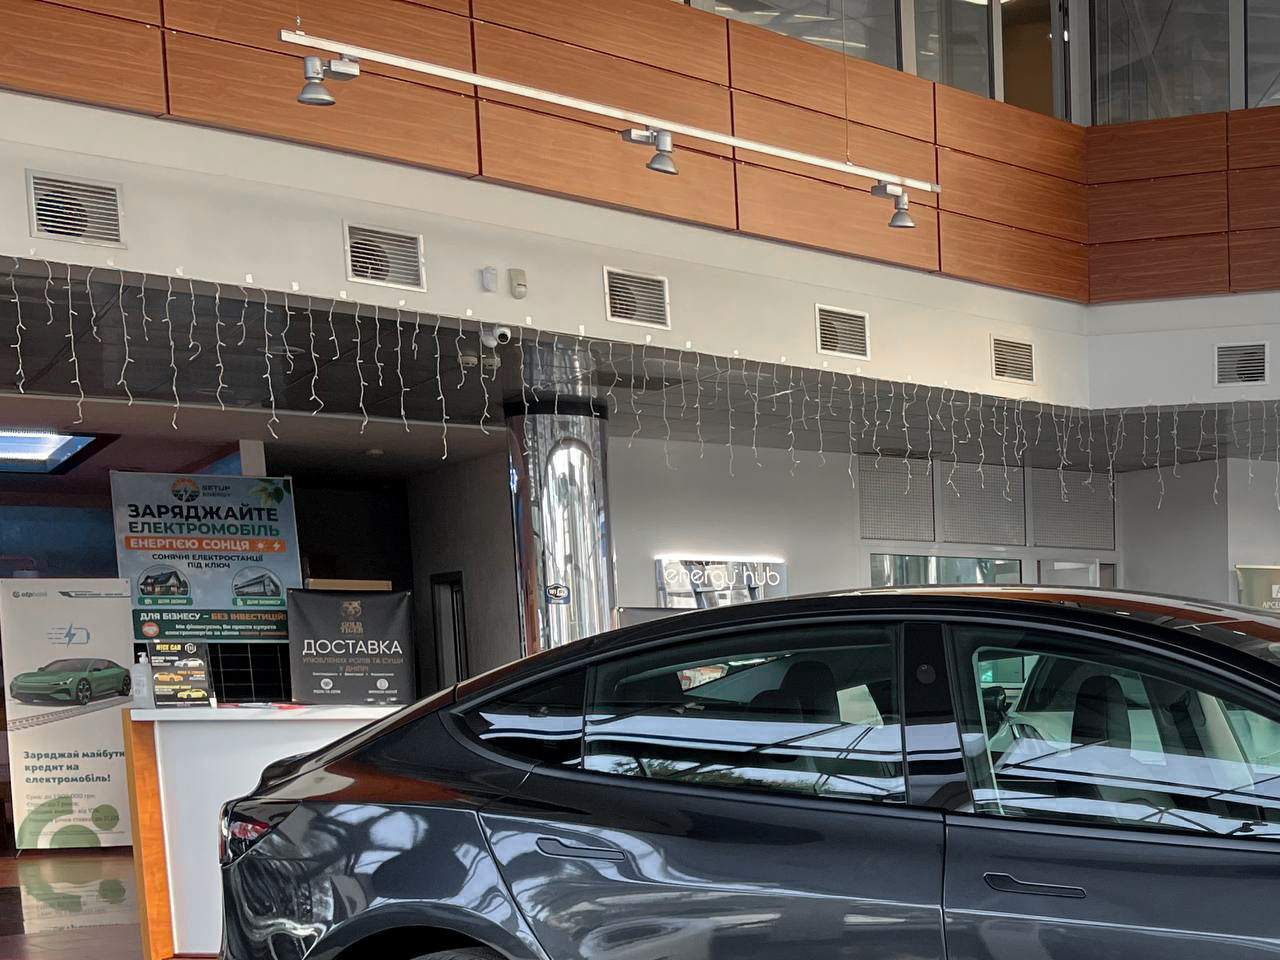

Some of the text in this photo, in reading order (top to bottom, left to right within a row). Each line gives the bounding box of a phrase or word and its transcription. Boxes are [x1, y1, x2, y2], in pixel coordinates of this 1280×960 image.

[127, 503, 279, 521] ЗАРЯДЖАЙТЕ
[128, 521, 280, 536] ЕЛЕКТРОМОБІЛЬ
[130, 538, 250, 551] ЕНЕРГІЄЮ СОНЦЯ
[192, 554, 264, 562] ЕЛЕКТРОСТАНЦІЇ
[187, 562, 203, 570] ПІД
[664, 565, 780, 590] energy hub
[139, 612, 161, 621] ДЛЯ
[162, 612, 201, 620] БІЗНЕСУ
[211, 612, 228, 620] БЕЗ
[302, 639, 403, 656] ДОСТАВКА
[23, 749, 125, 761] Заряджай майбутн
[24, 764, 64, 773] кредит
[25, 773, 111, 784] електромобіль!
